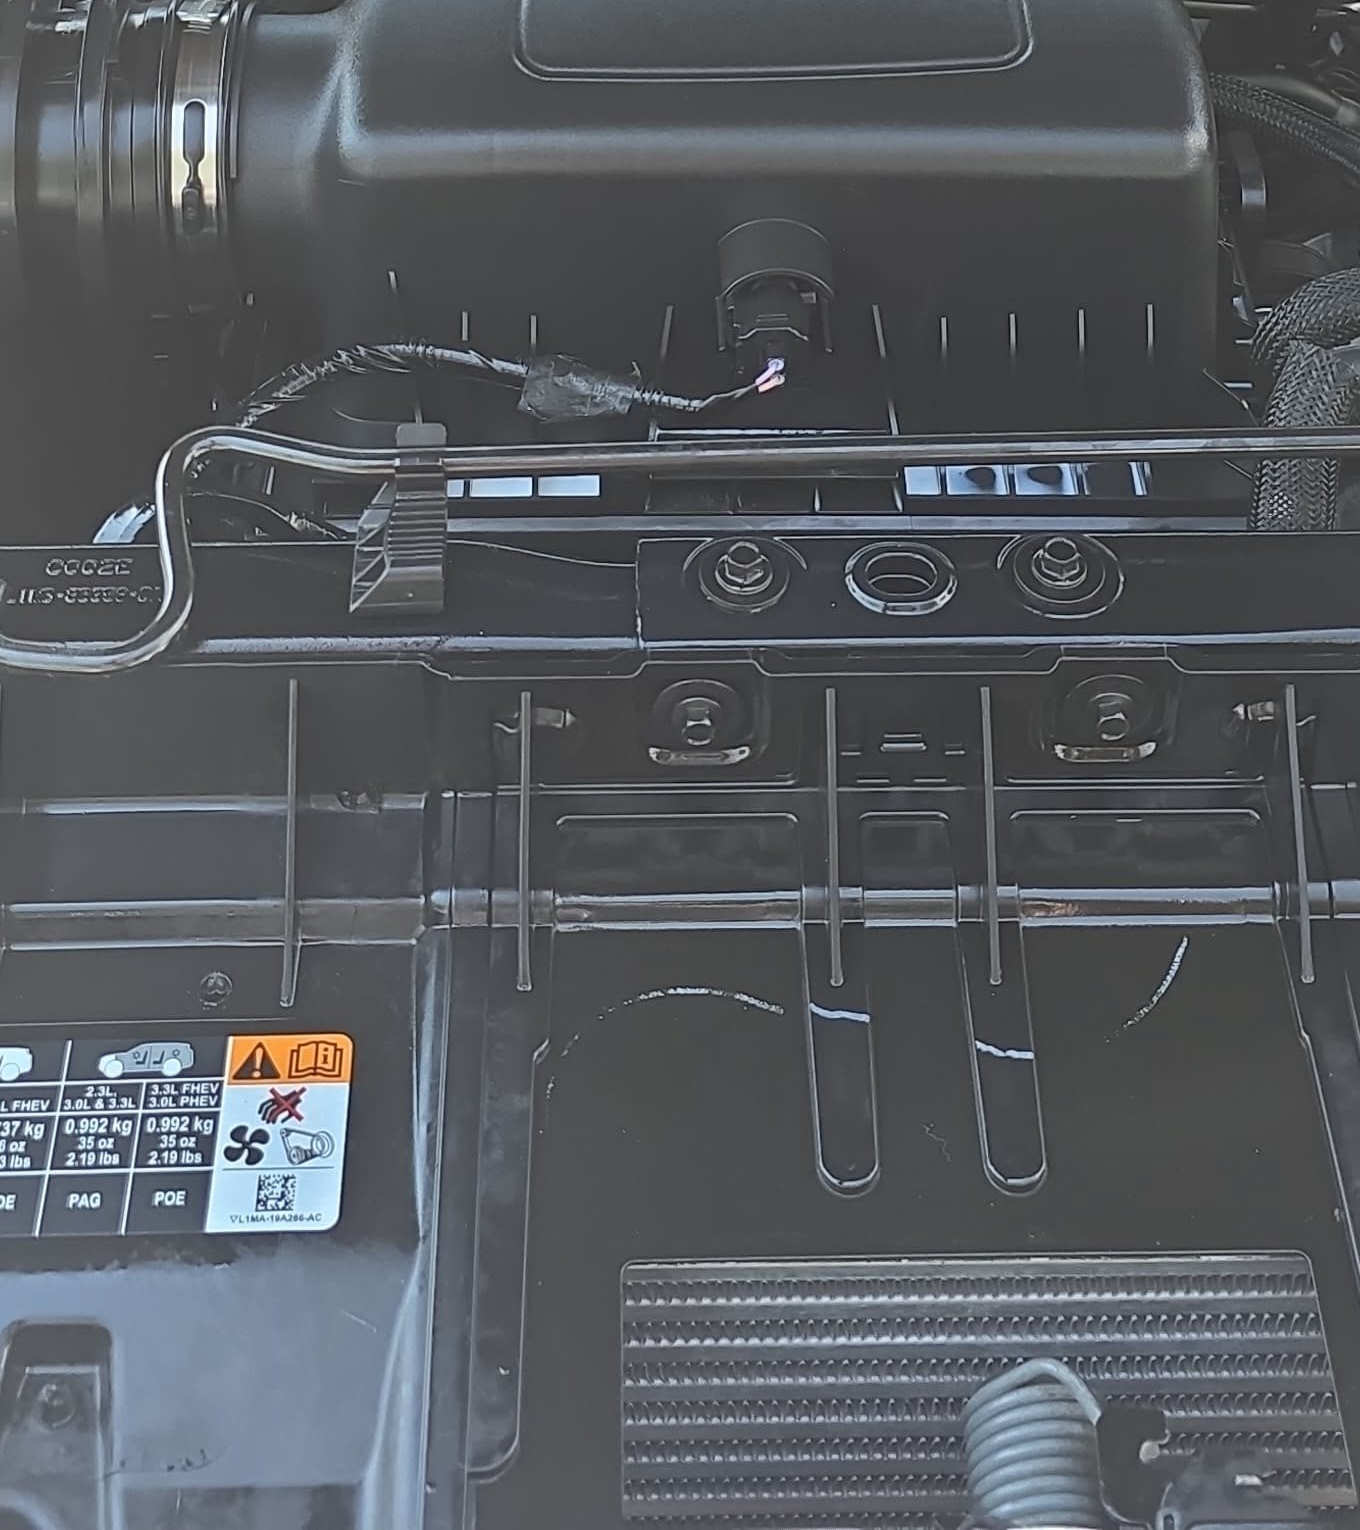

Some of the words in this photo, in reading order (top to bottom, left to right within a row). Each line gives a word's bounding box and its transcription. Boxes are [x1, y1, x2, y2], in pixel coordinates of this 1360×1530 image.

[151, 1083, 179, 1095] 3.3L
[182, 1082, 220, 1095] FHEV
[12, 1099, 51, 1112] FHEV
[63, 1098, 93, 1111] 3.0L
[94, 1098, 105, 1110] &
[108, 1096, 137, 1109] 3.3L
[148, 1096, 177, 1109] 3.0L
[180, 1095, 219, 1108] PHEV
[24, 1120, 45, 1140] kg
[64, 1118, 108, 1135] 0.992
[111, 1118, 133, 1137] kg
[146, 1116, 191, 1133] 0.992
[193, 1115, 215, 1135] kg
[10, 1141, 27, 1152] oz
[77, 1136, 96, 1150] 35
[98, 1138, 115, 1150] oz
[158, 1135, 177, 1148] 35
[180, 1136, 197, 1148] oz
[10, 1155, 32, 1169] lbs
[65, 1152, 96, 1167] 2.19
[99, 1151, 120, 1166] lbs
[148, 1151, 178, 1166] 2.19
[181, 1150, 203, 1165] lbs
[68, 1192, 102, 1209] PAG
[153, 1190, 187, 1206] POE
